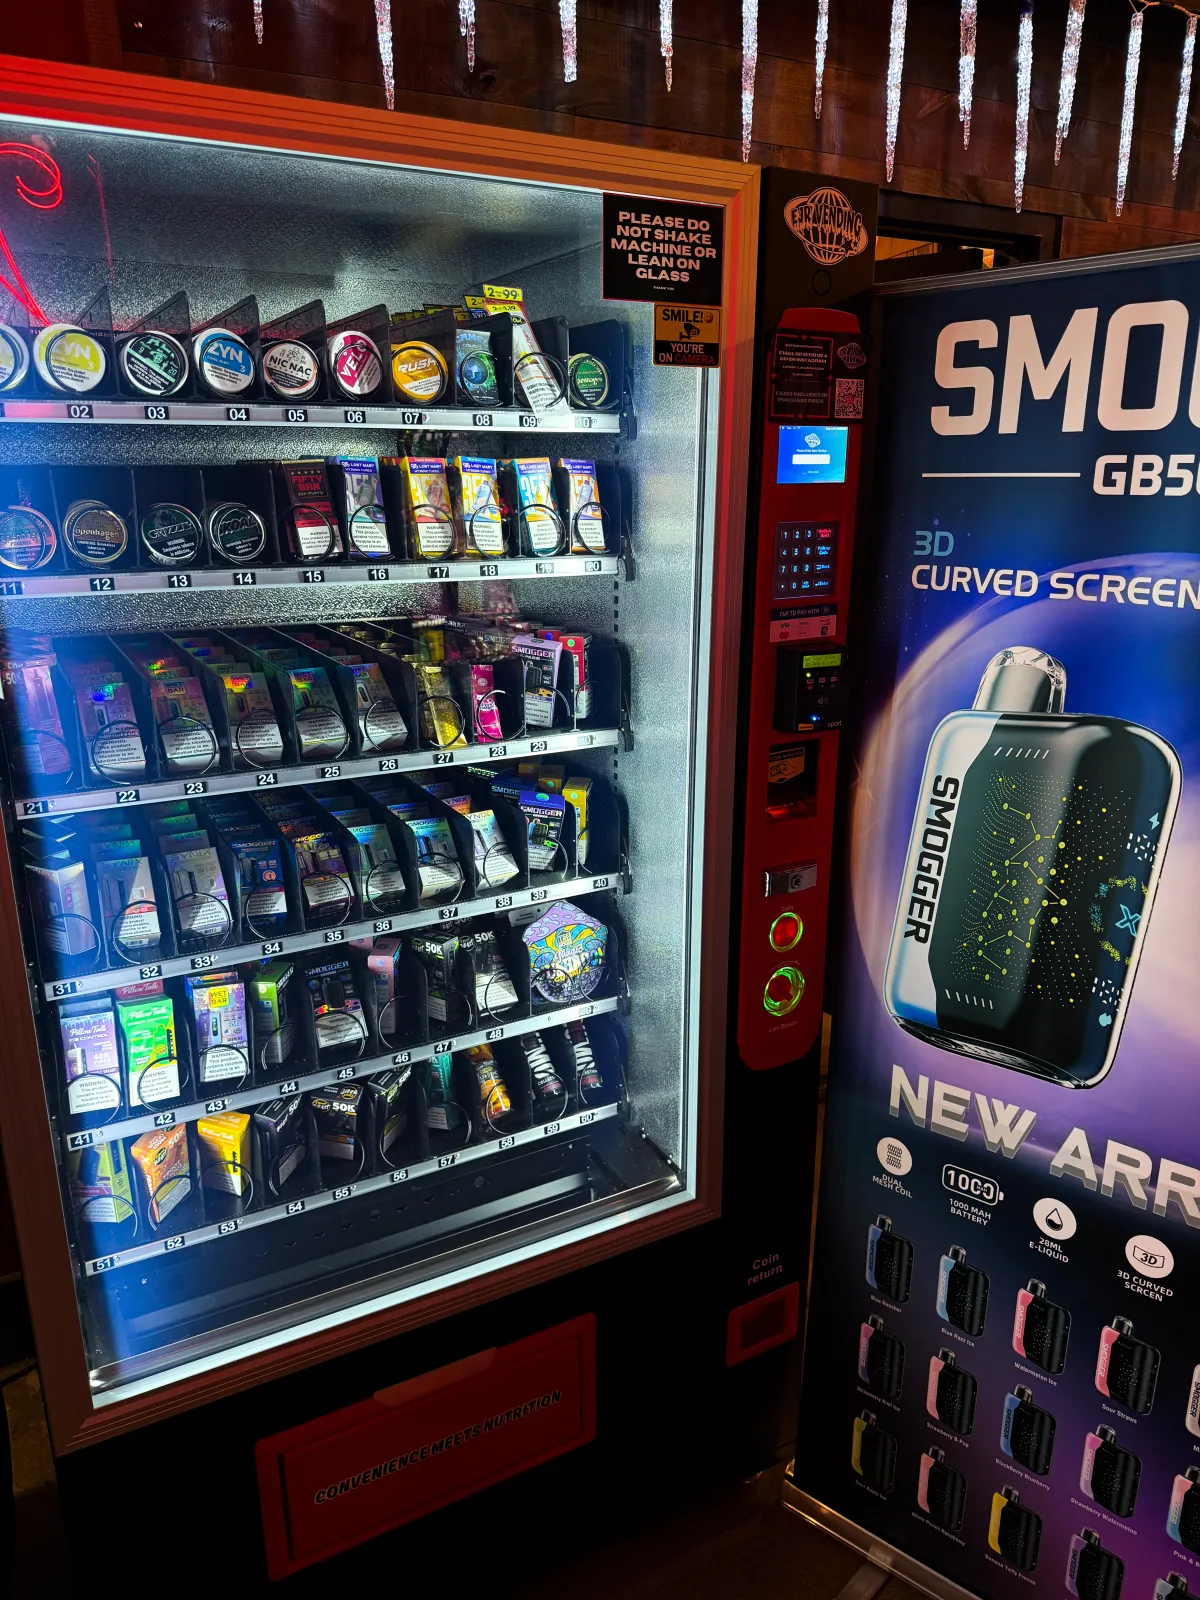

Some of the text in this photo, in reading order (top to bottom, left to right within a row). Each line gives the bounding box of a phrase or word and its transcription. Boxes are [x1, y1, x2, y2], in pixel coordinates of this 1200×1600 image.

[618, 211, 710, 232] PLEASE DO
[814, 202, 863, 239] VENDING
[616, 224, 712, 245] NOT SHAKE
[610, 238, 717, 259] MACHINE OR
[628, 253, 701, 271] LEAN ON
[635, 268, 690, 283] GLASS
[487, 287, 496, 297] 2
[662, 309, 704, 324] SMILE!
[208, 342, 243, 364] ZYN
[670, 343, 705, 354] YOU'RE
[397, 357, 437, 373] RUSH
[659, 353, 715, 365] ON CAMERA
[269, 355, 288, 368] NIC
[288, 362, 313, 376] NAC
[930, 299, 1200, 436] SMO
[71, 405, 90, 418] 02
[147, 406, 166, 420] 03
[229, 408, 247, 421] 04
[288, 409, 305, 422] 05
[347, 411, 363, 423] 06
[404, 412, 420, 424] 07
[475, 414, 491, 426] 08
[522, 416, 537, 427] 09
[291, 475, 323, 485] FIFTY
[1093, 454, 1200, 497] GB5
[297, 483, 321, 491] BAR
[913, 530, 955, 557] 3D
[482, 566, 496, 576] 18
[587, 561, 600, 571] 20
[305, 571, 322, 582] 15
[371, 569, 386, 580] 16
[434, 567, 448, 578] 17
[92, 578, 112, 591] 12
[170, 576, 188, 587] 13
[236, 573, 254, 585] 14
[0, 582, 17, 594] 11
[911, 564, 1200, 610] CURVED SCREEN
[511, 645, 555, 659] SMOGGER
[827, 720, 842, 728] eport
[491, 747, 505, 757] 28
[532, 741, 546, 751] 29
[437, 753, 451, 763] 27
[381, 760, 397, 770] 26
[324, 767, 340, 777] 25
[259, 774, 276, 785] 24
[186, 783, 204, 794] 23
[118, 791, 137, 802] 22
[27, 803, 44, 814] 21
[520, 805, 563, 818] SMOGGER
[231, 840, 276, 849] SMOGGER
[171, 848, 212, 860] SYNIX
[904, 774, 960, 945] SMOGGER
[594, 879, 607, 887] 40
[533, 891, 545, 899] 39
[497, 897, 510, 907] 38
[442, 908, 456, 918] 37
[781, 904, 794, 913] Coin
[375, 921, 390, 931] 36
[327, 931, 342, 942] 35
[474, 930, 496, 943] 50K
[264, 943, 280, 954] 34
[425, 941, 443, 956] 50K
[194, 956, 211, 968] 33
[142, 966, 159, 978] 32
[305, 960, 349, 977] SMOGGER
[55, 984, 72, 995] 31
[143, 981, 158, 991] Talk
[210, 990, 227, 998] WET
[211, 997, 228, 1005] BAR
[151, 1006, 167, 1016] Talk
[69, 1024, 107, 1037] Pillow Talk
[489, 1029, 502, 1038] 48
[768, 1024, 780, 1034] Coin
[436, 1043, 449, 1052] 47
[93, 1052, 111, 1061] 40K
[395, 1053, 409, 1062] 46
[339, 1068, 354, 1078] 45
[281, 1083, 297, 1093] 44
[207, 1100, 224, 1111] 43
[332, 1101, 356, 1113] 50K
[888, 1063, 1037, 1159] NEW
[156, 1113, 173, 1124] 42
[581, 1114, 593, 1123] 60
[547, 1125, 558, 1133] 59
[74, 1134, 91, 1145] 41
[168, 1129, 186, 1149] 50K
[501, 1138, 513, 1147] 58
[440, 1156, 452, 1166] 57
[393, 1171, 407, 1181] 56
[882, 1173, 903, 1188] DUAL
[872, 1175, 913, 1199] MESH COIL
[335, 1189, 349, 1199] 55
[288, 1202, 303, 1213] 54
[949, 1198, 991, 1220] 1000 MAH
[950, 1206, 988, 1226] BATTERY
[220, 1222, 236, 1233] 53
[167, 1237, 183, 1248] 52
[1039, 1237, 1063, 1253] 28ML
[1029, 1241, 1069, 1263] E-LIQUID
[96, 1258, 112, 1270] 51
[752, 1253, 779, 1270] Coin
[1140, 1252, 1158, 1266] 3D
[747, 1265, 783, 1285] return
[1117, 1269, 1174, 1298] 3D CURVED
[1015, 1305, 1025, 1339] SMOGGER
[1098, 1342, 1109, 1378] SMOGGER
[1014, 1361, 1058, 1387] Watermelon Ice
[1189, 1380, 1200, 1418] SMOGGER
[1101, 1403, 1138, 1425] Sour Straws
[1003, 1408, 1013, 1441] SMOGGER
[926, 1421, 953, 1441] Strawberry
[314, 1389, 562, 1505] CONVENIENCE MEETS NUTRITION
[1024, 1472, 1051, 1492] Blueberry
[1070, 1497, 1138, 1536] Strawberry Watermelon
[1173, 1550, 1187, 1561] Pink
[1188, 1557, 1194, 1565] &
[1068, 1548, 1079, 1580] SMOGGER
